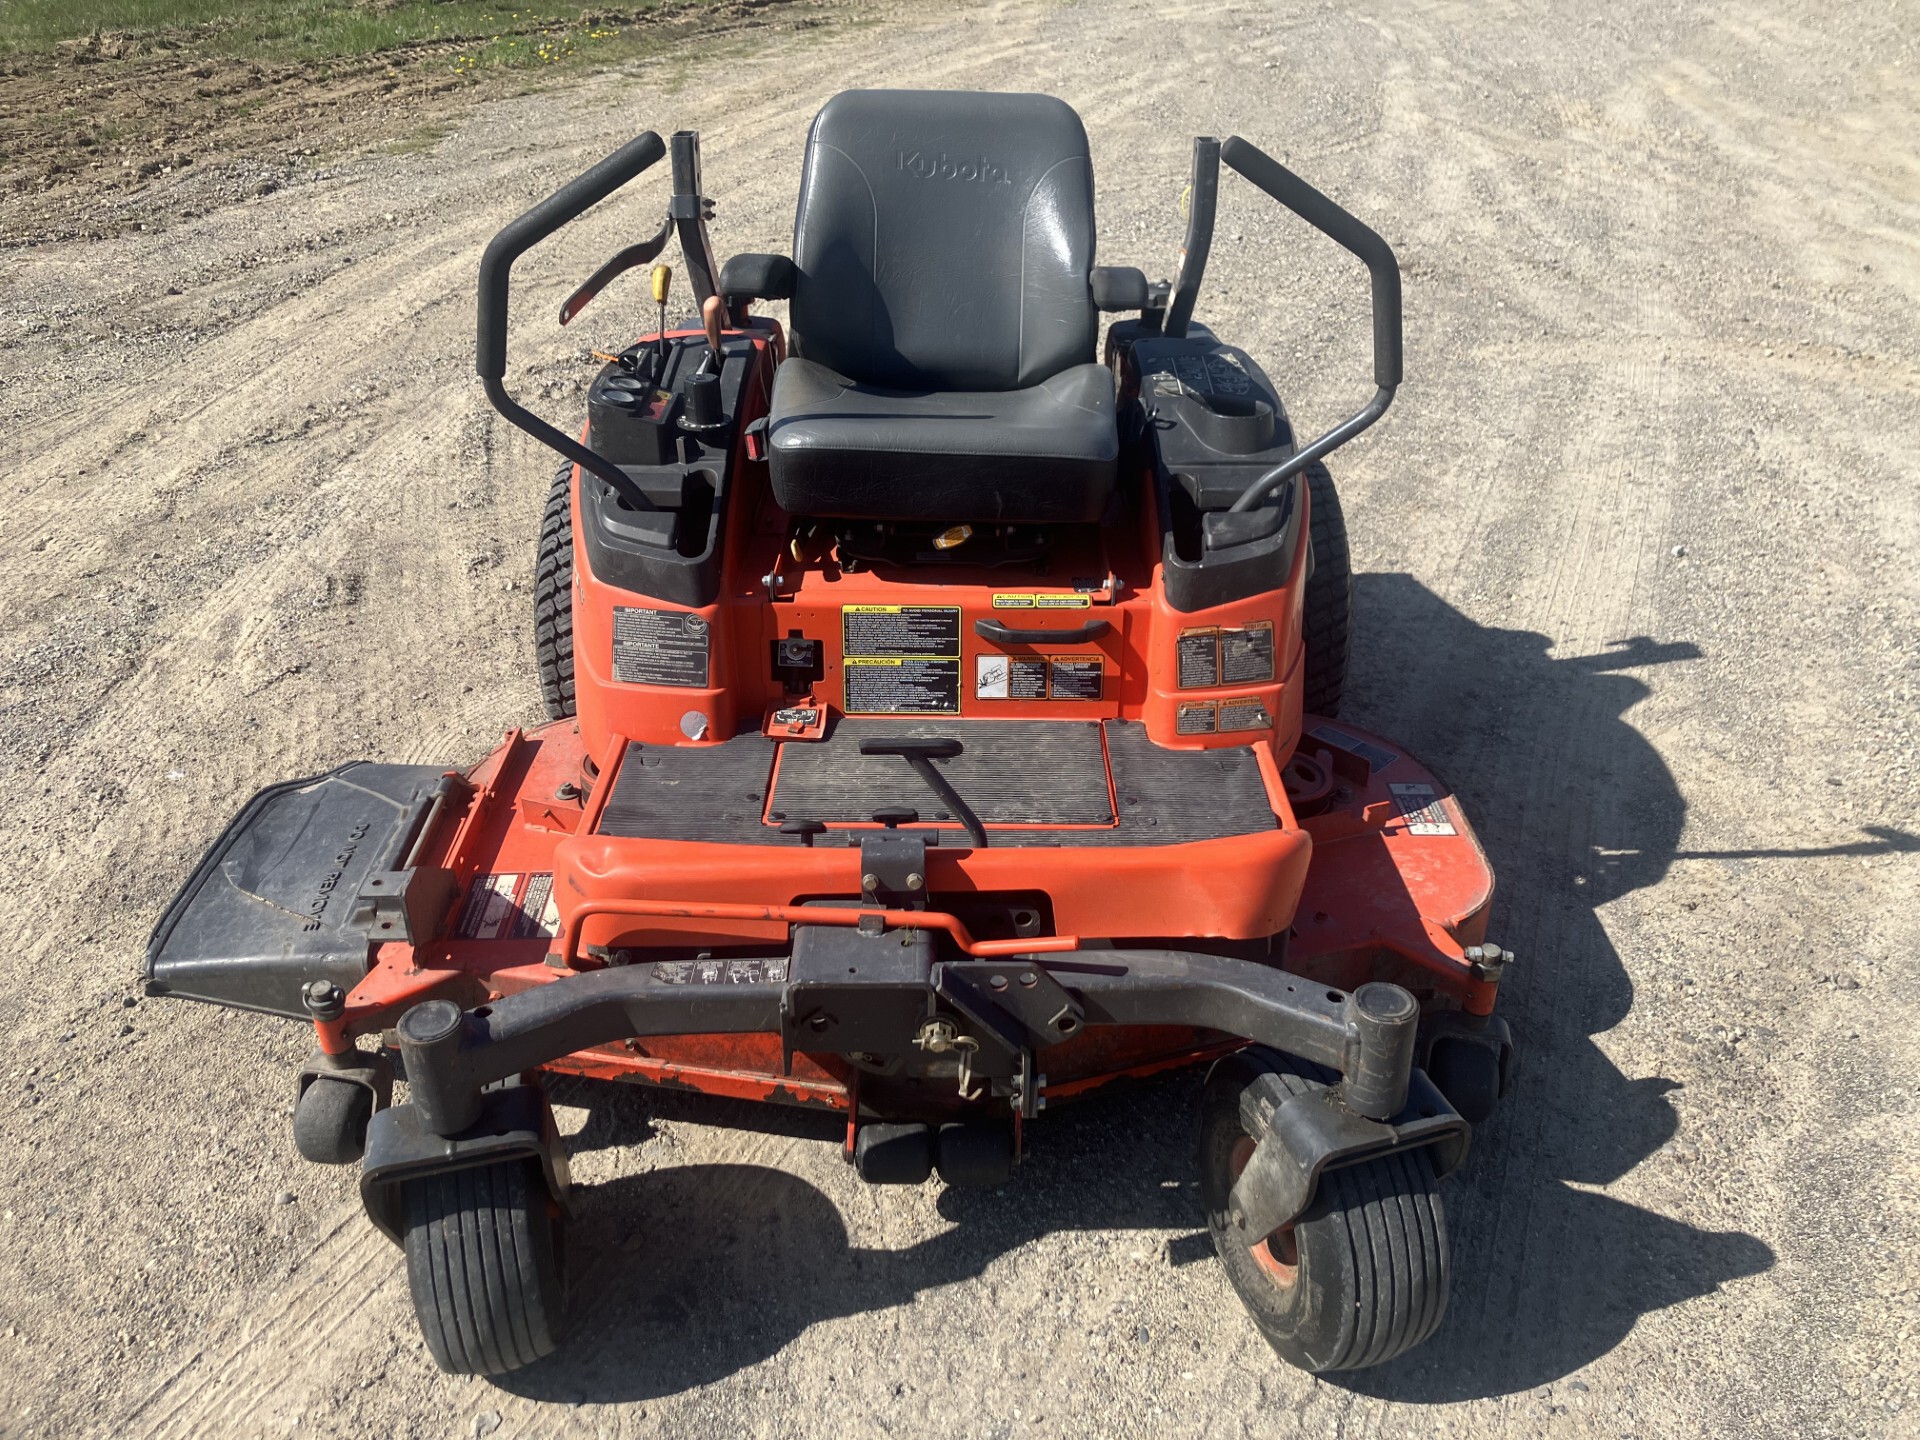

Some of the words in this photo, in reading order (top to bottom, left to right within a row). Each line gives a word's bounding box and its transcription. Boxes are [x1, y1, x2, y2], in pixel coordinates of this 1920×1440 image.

[896, 150, 1012, 184] Kubota
[624, 607, 657, 615] IMPORTANT
[622, 640, 659, 648] IMPORTANTE
[347, 822, 371, 842] DO
[335, 844, 358, 868] NOT
[303, 870, 343, 932] REMOVE
